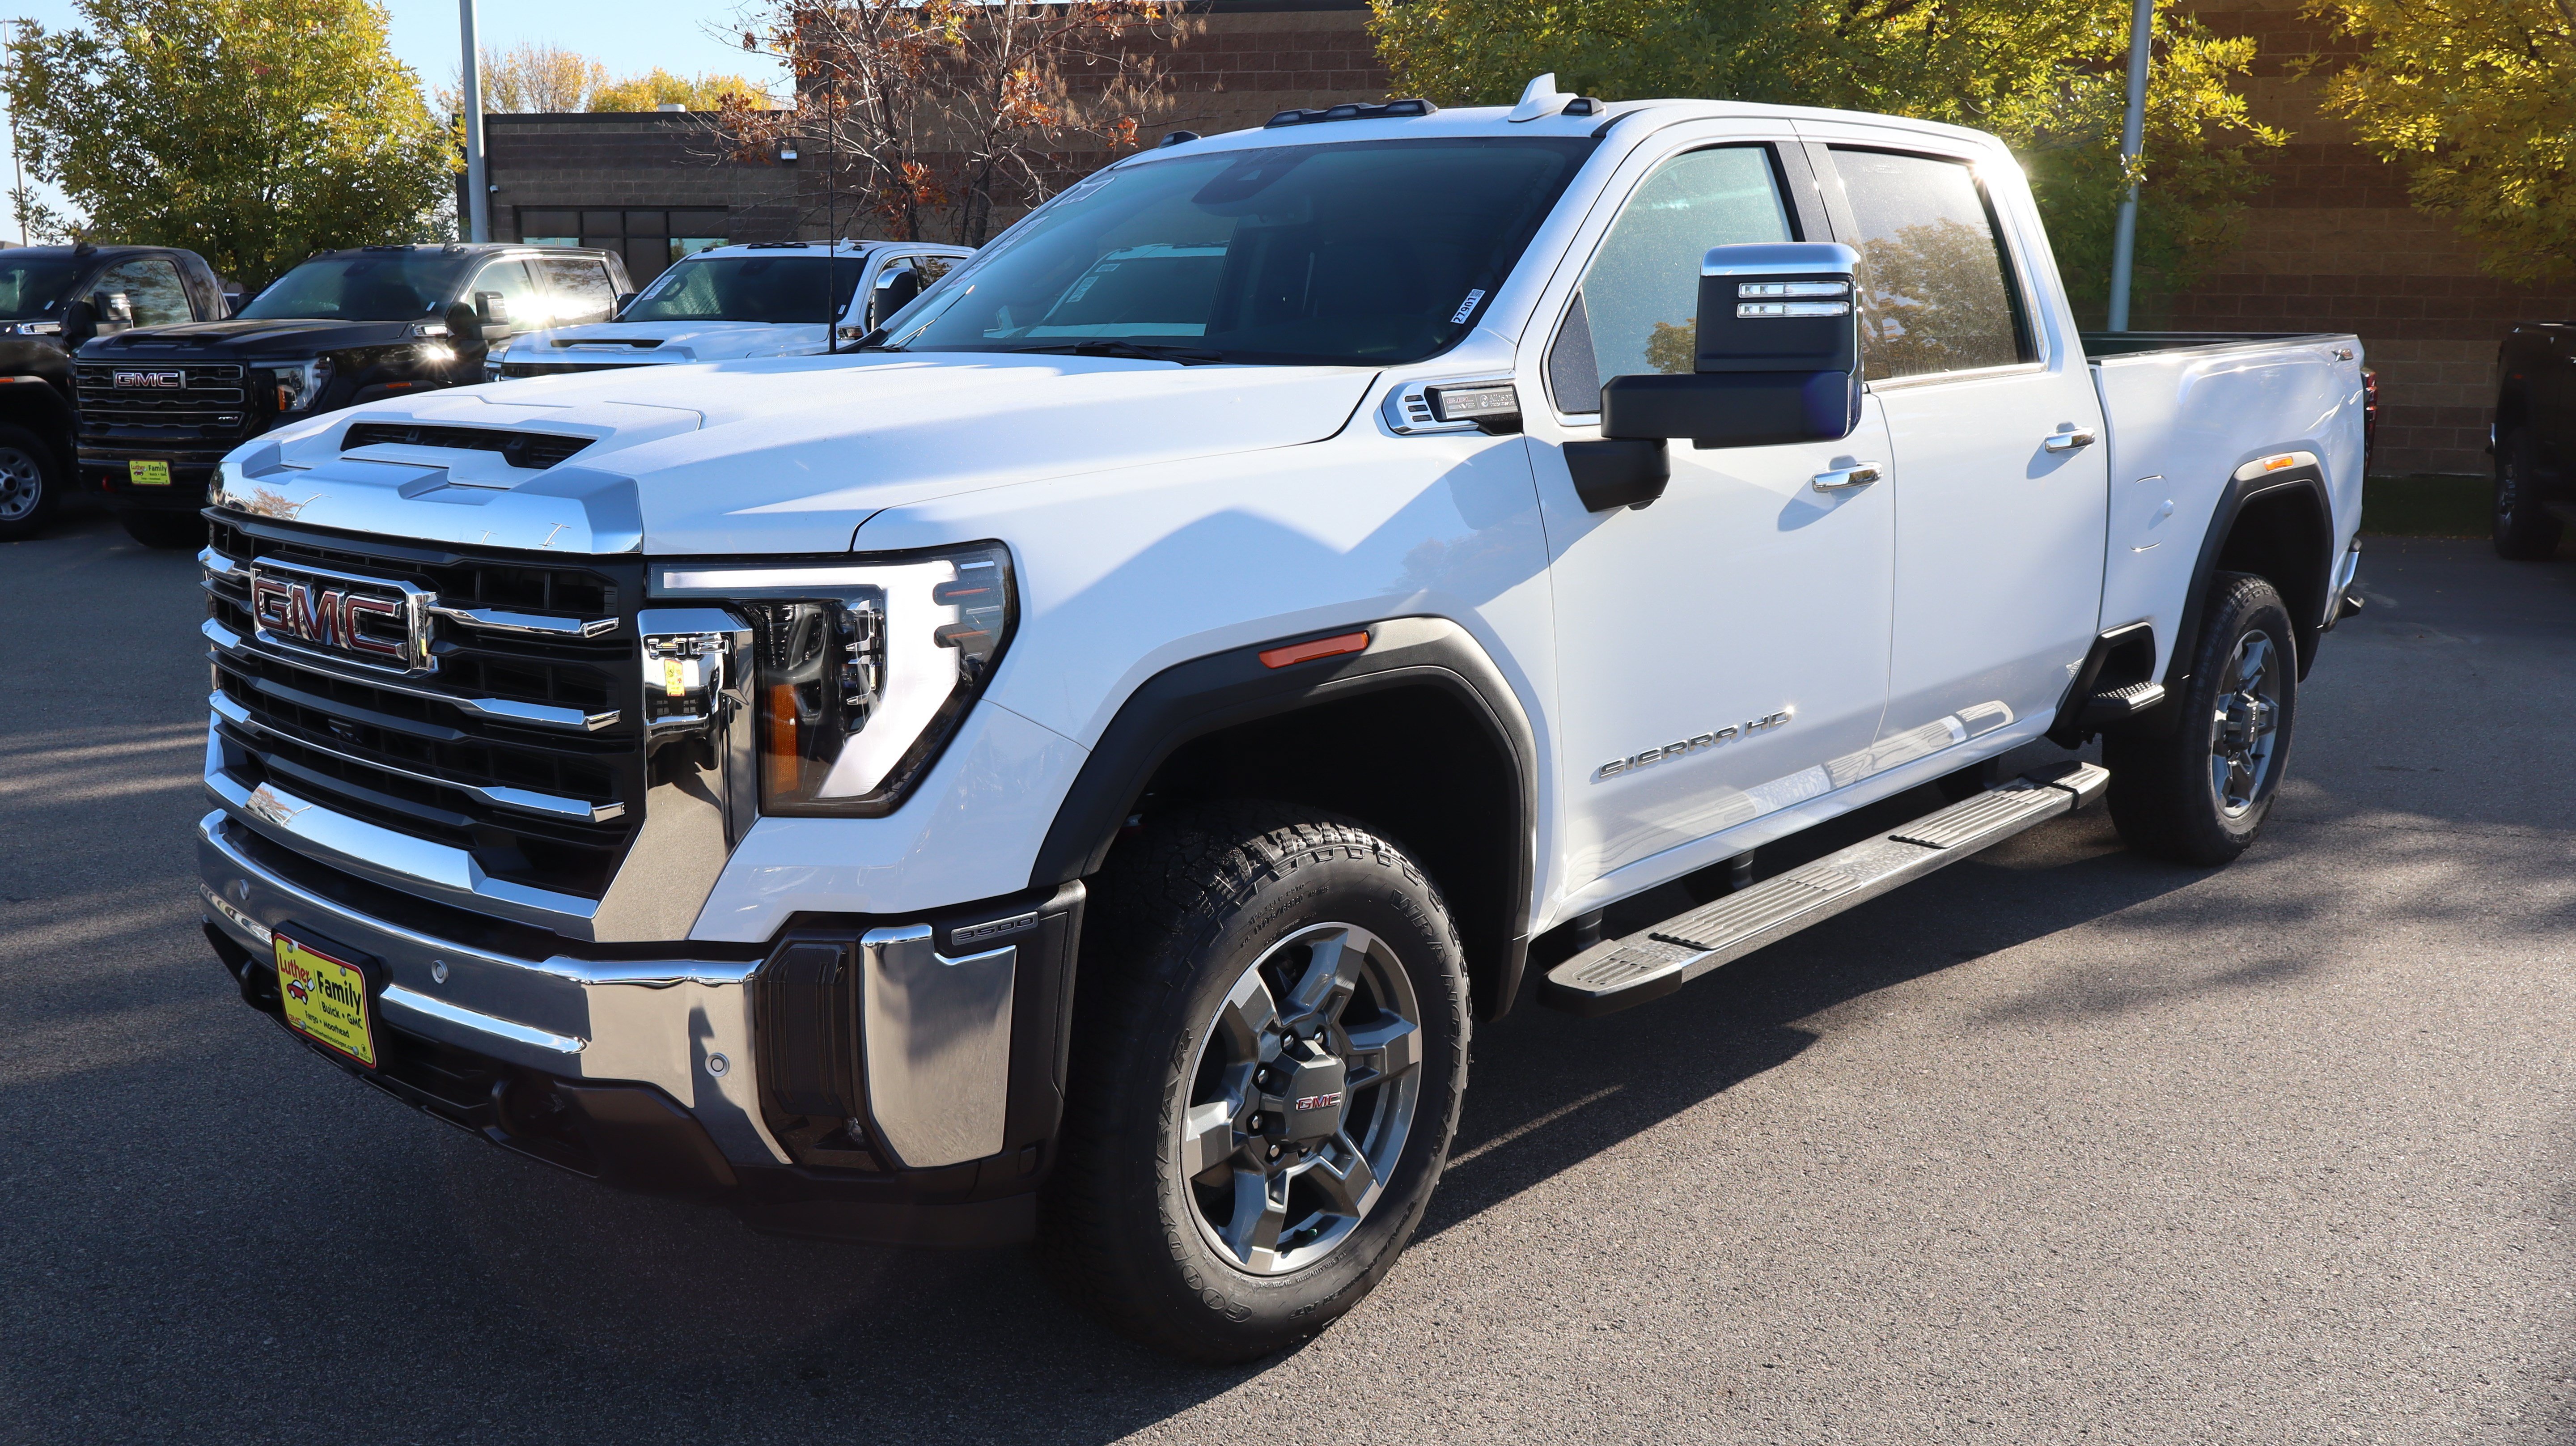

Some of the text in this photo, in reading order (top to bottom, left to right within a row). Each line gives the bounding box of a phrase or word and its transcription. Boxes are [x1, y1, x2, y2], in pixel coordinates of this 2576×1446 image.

[1453, 297, 1476, 322] 27901
[115, 372, 178, 387] GMC
[148, 464, 167, 473] Family
[254, 576, 408, 660] GMC
[1598, 709, 1792, 778] SIERRA HD
[957, 917, 1034, 941] 3500
[278, 953, 361, 1016] Luther Family
[305, 1010, 350, 1039] Fargo Moorhead
[321, 1001, 363, 1030] Buick GMC
[1390, 888, 1463, 1157] WRANGLER
[1296, 1091, 1341, 1111] GMC
[1155, 1027, 1252, 1323] GOODYEAR
